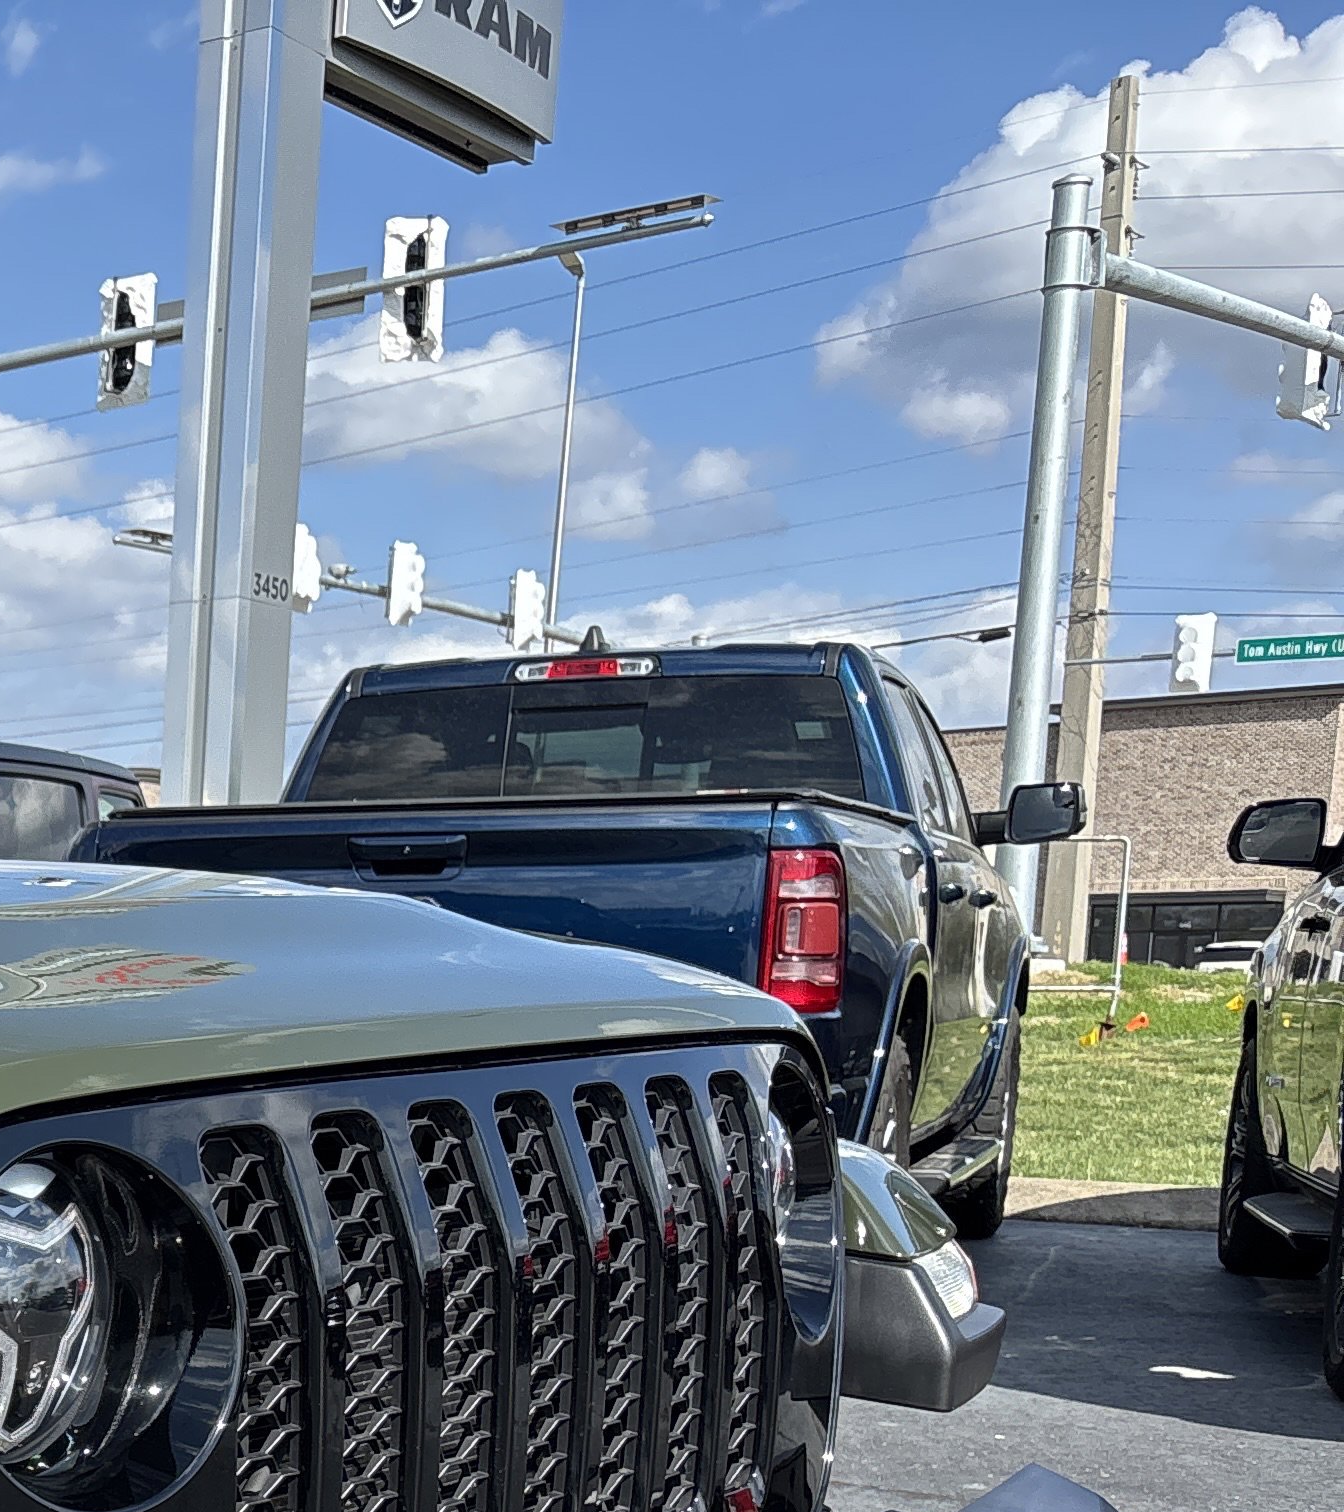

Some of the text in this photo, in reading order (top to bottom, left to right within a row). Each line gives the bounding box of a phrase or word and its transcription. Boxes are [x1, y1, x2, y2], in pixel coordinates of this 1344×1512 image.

[253, 573, 289, 602] 3450
[1243, 643, 1264, 658] Tom
[1267, 641, 1301, 656] Austin
[1305, 640, 1328, 656] Hwy
